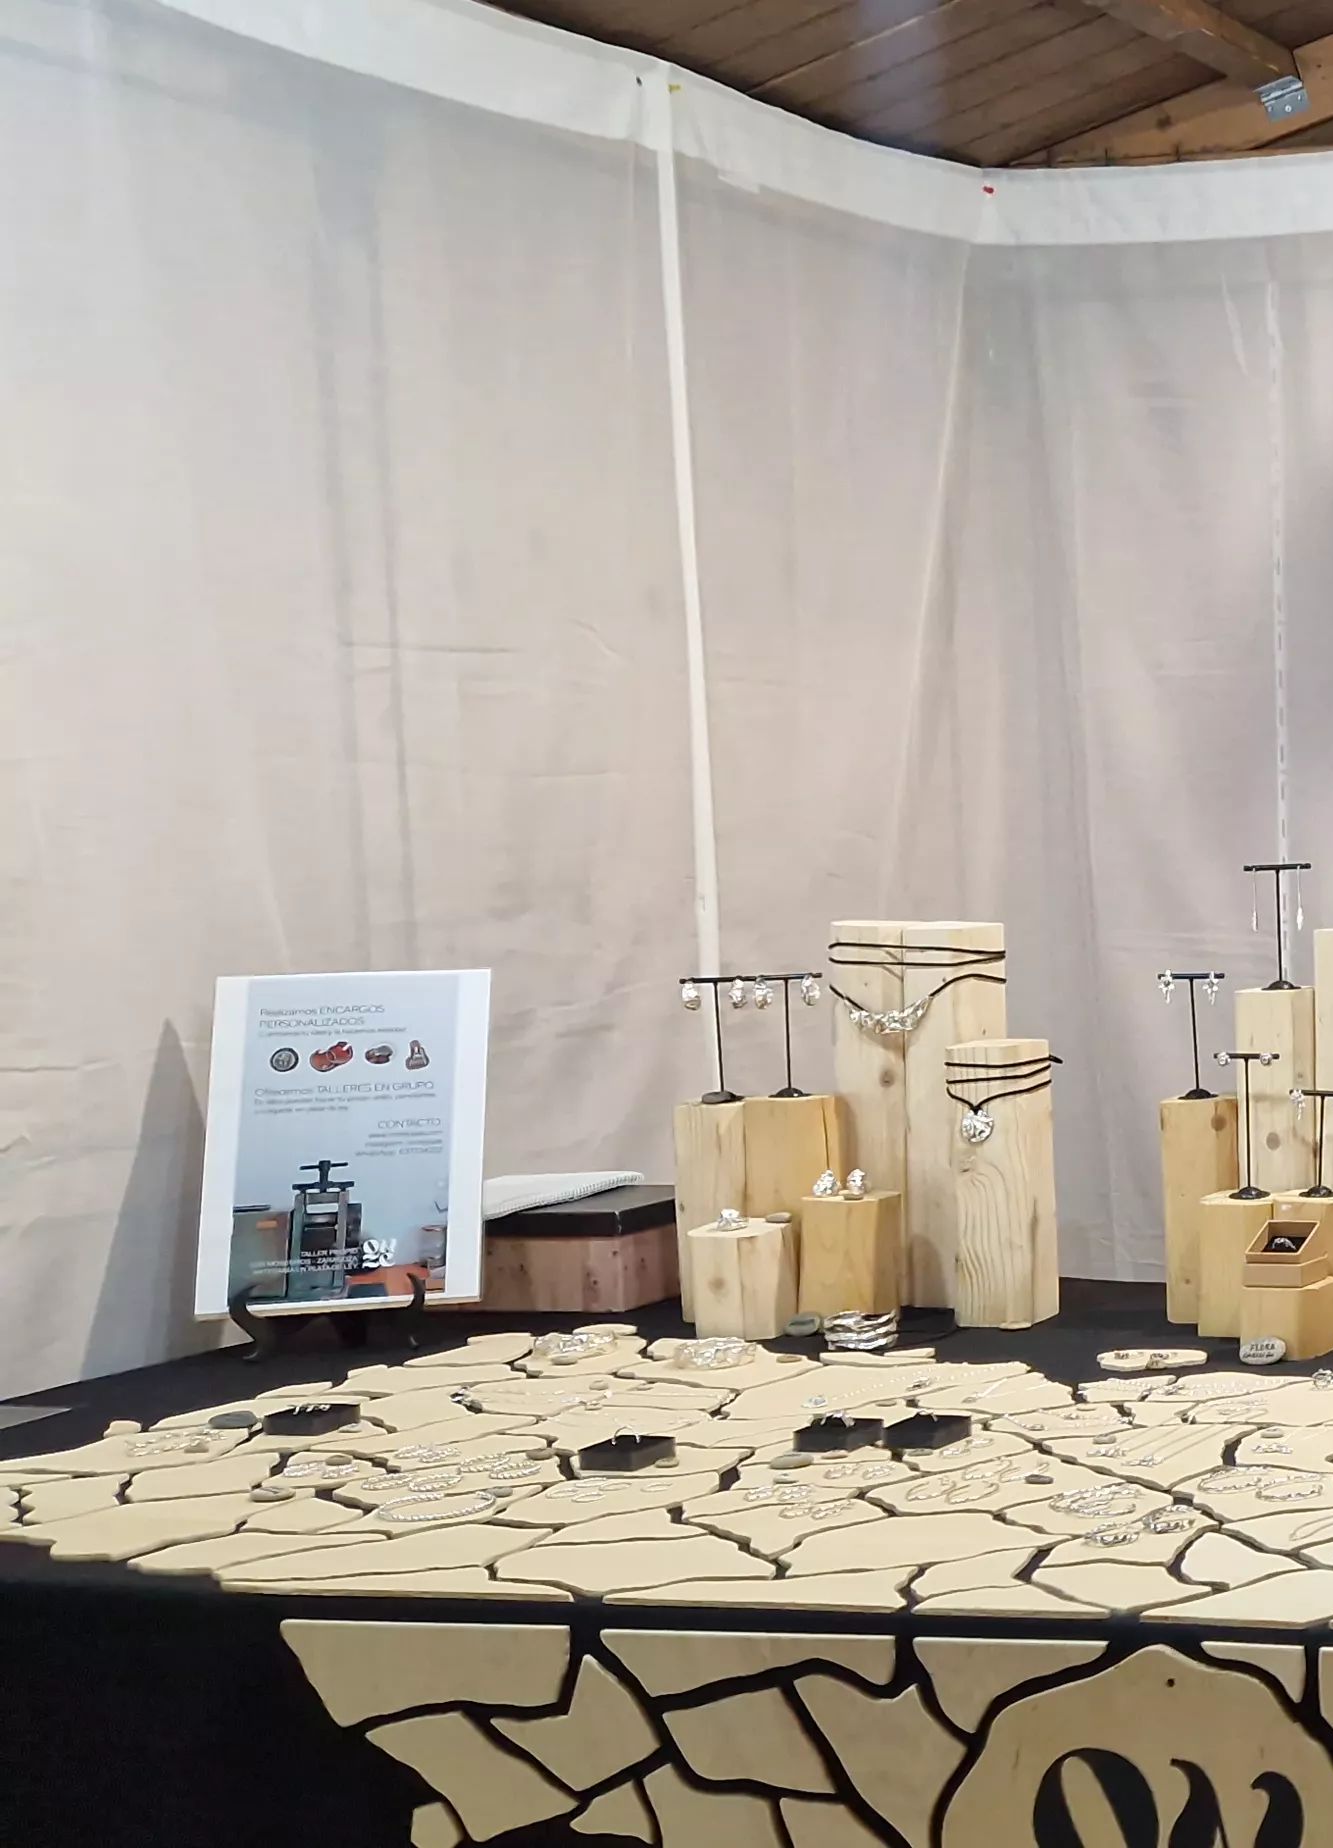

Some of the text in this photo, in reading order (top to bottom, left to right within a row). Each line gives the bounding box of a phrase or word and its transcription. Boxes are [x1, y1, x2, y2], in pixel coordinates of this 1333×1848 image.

[319, 1004, 385, 1014] ENCARGOS
[259, 1016, 364, 1028] PERSONALIZADOS
[316, 1083, 373, 1095] TALLERES
[391, 1080, 435, 1091] GRUPO
